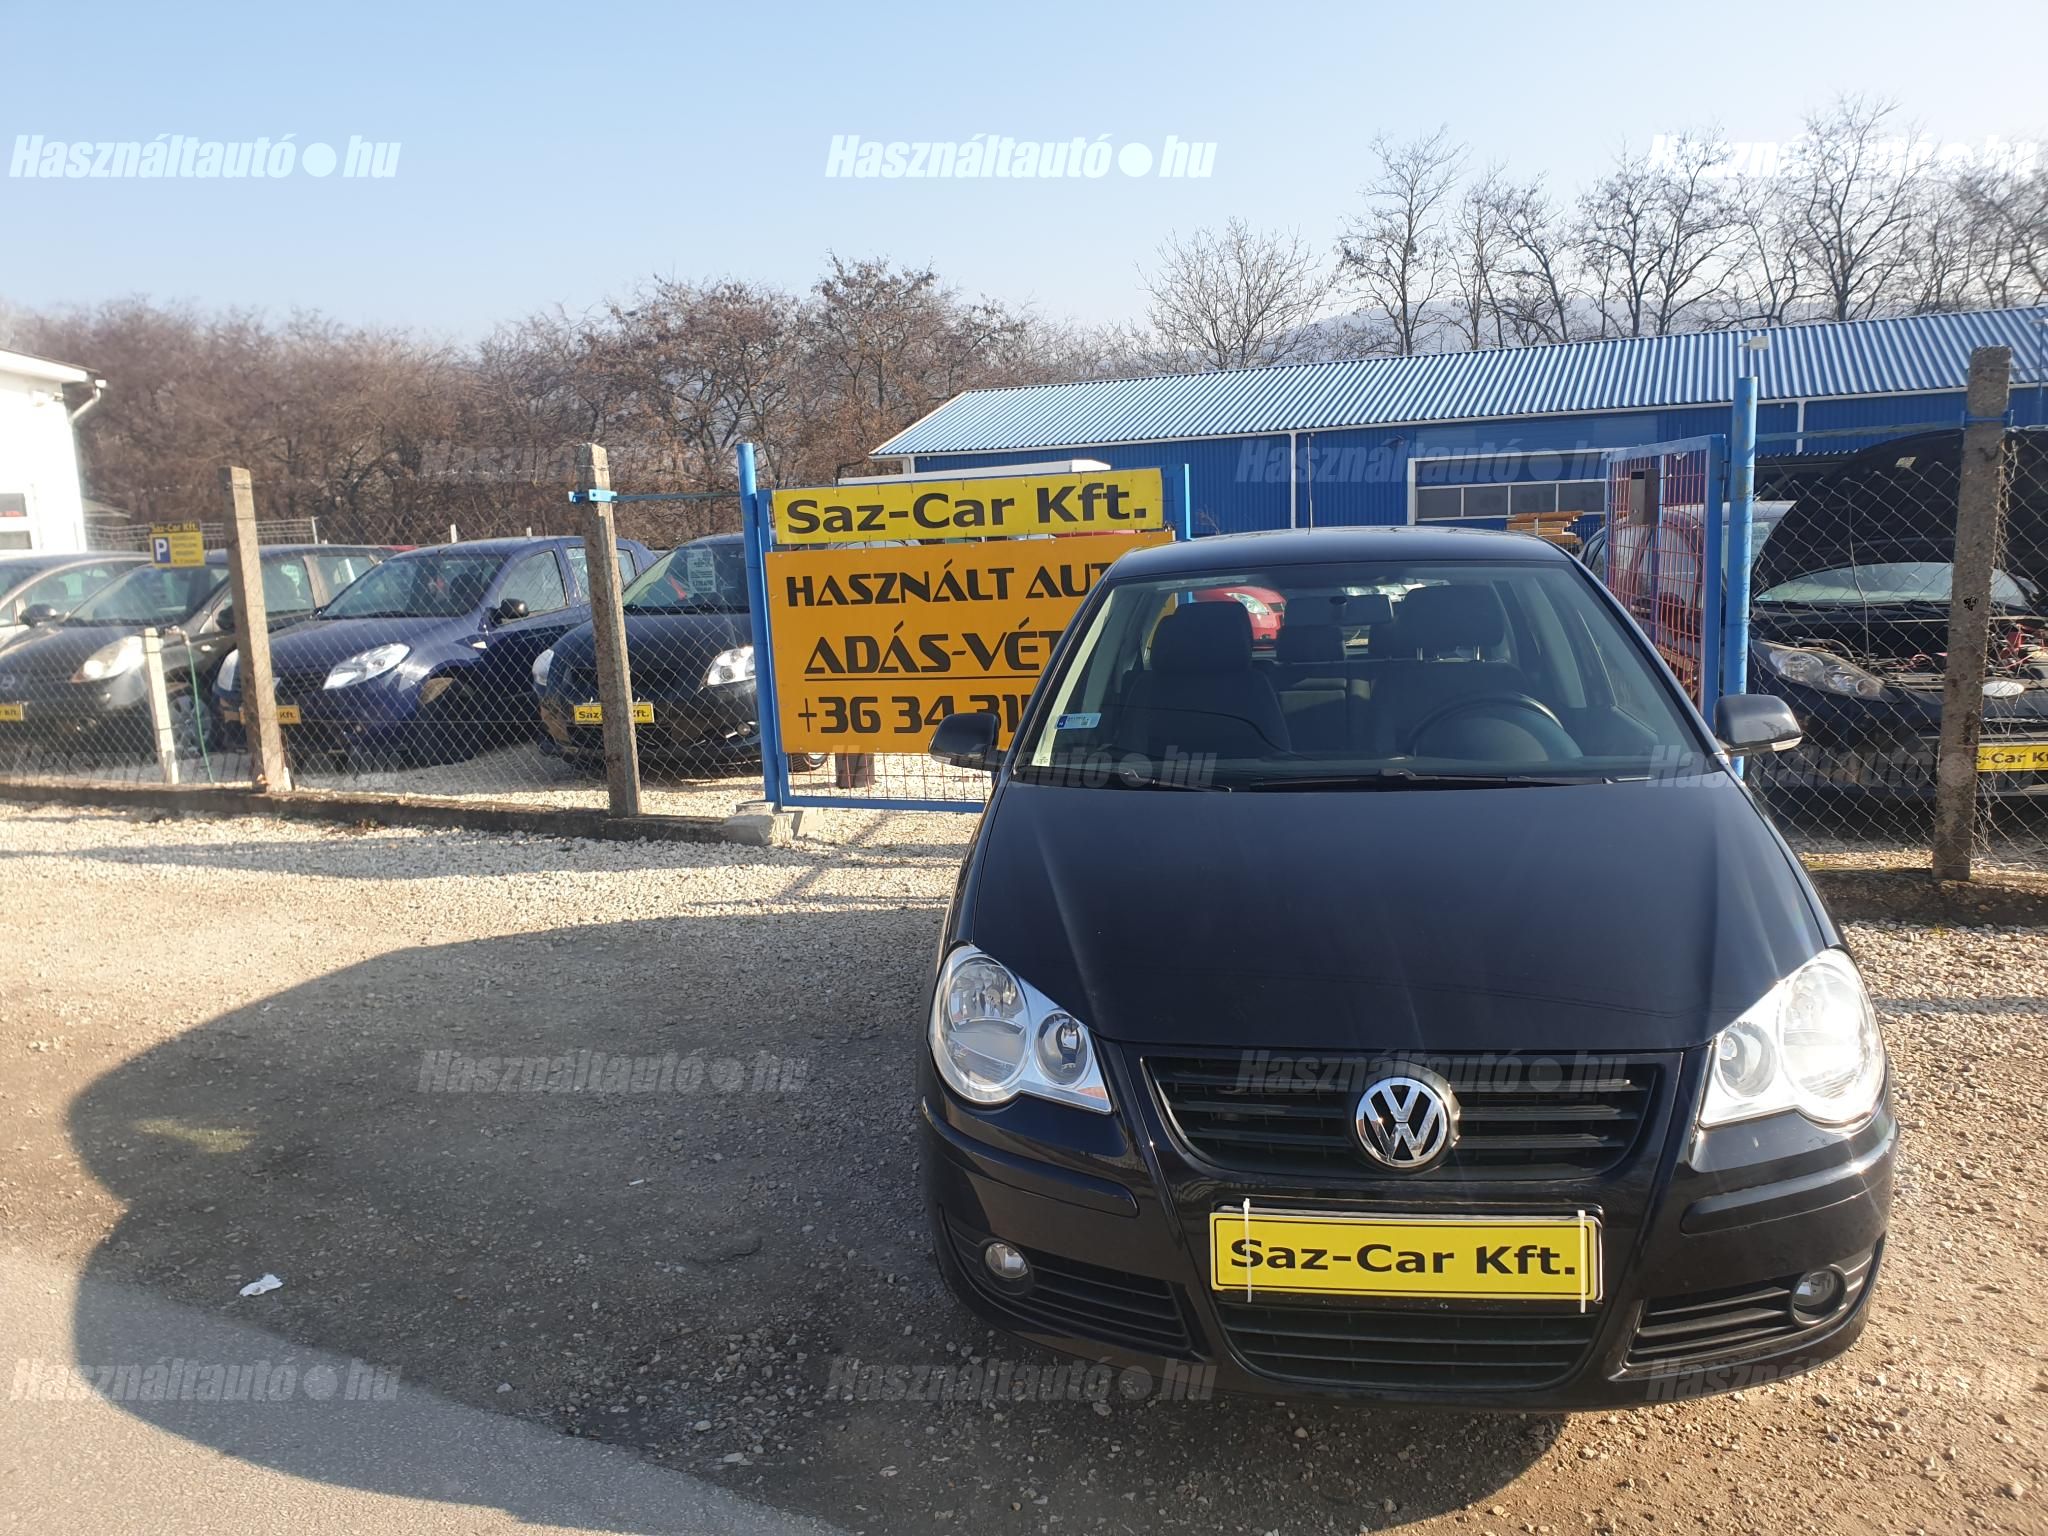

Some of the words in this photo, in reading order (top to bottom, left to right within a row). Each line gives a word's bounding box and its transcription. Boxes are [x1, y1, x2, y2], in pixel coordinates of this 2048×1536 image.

[787, 491, 1015, 534] Saz-Car
[1037, 482, 1147, 525] Kft.
[155, 539, 167, 561] P
[786, 558, 1015, 607] HASZNÁLT
[798, 695, 881, 734] +36
[893, 695, 956, 734] 34
[2032, 751, 2048, 763] K
[1230, 1238, 1455, 1275] Saz-Car
[1475, 1244, 1576, 1276] Kft.
